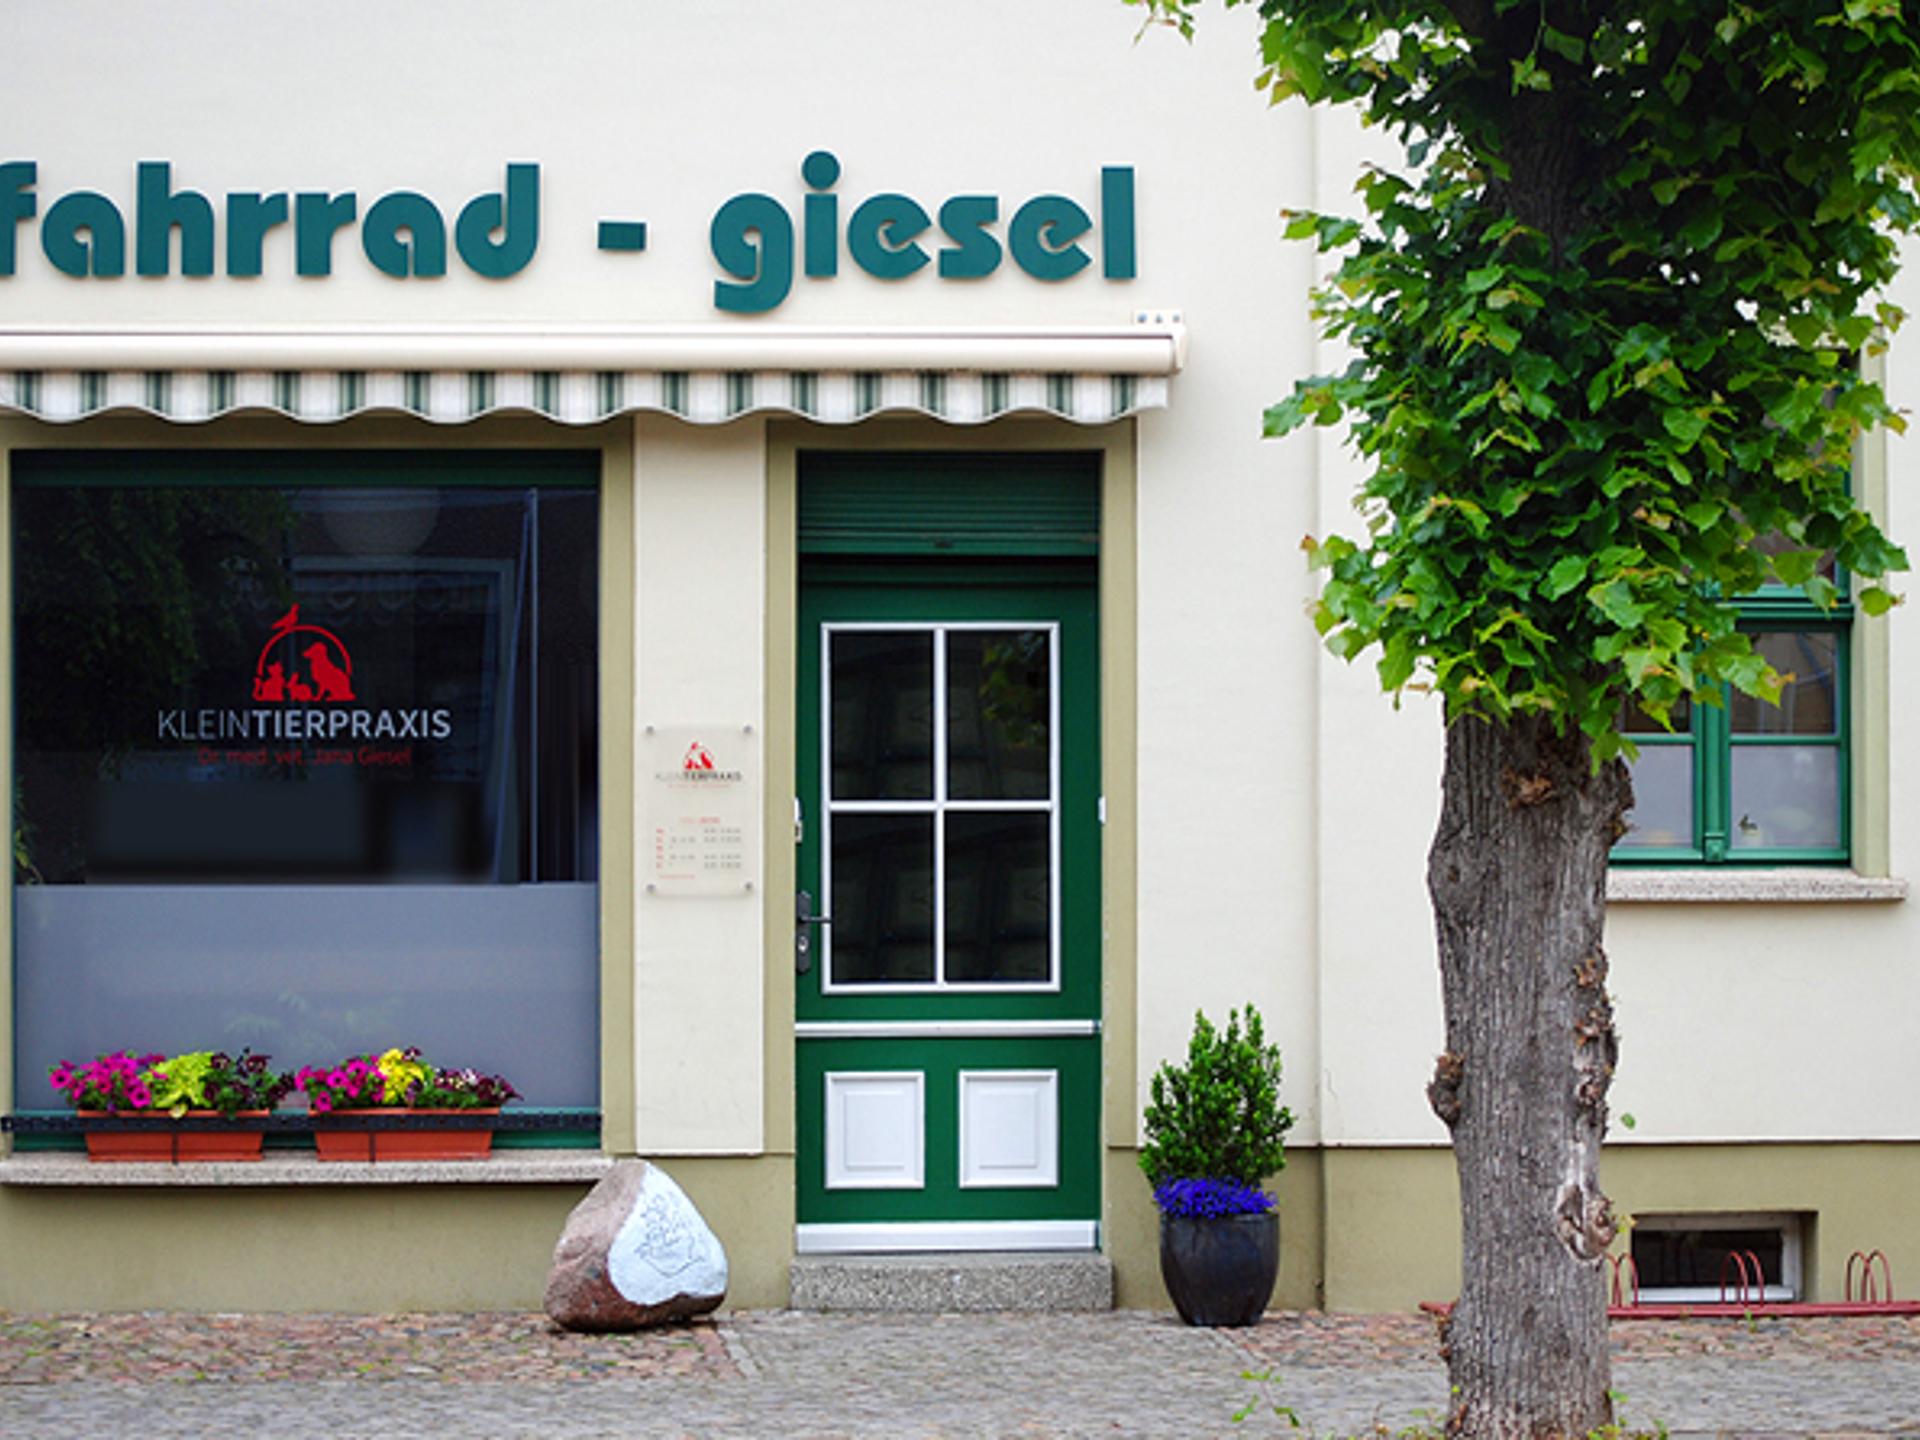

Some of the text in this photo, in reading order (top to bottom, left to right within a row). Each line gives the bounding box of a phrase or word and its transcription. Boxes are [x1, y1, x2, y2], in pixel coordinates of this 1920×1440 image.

[0, 161, 539, 277] fahrrad
[710, 151, 1136, 313] giesel
[157, 709, 452, 739] KLEINTIERPRAXIS
